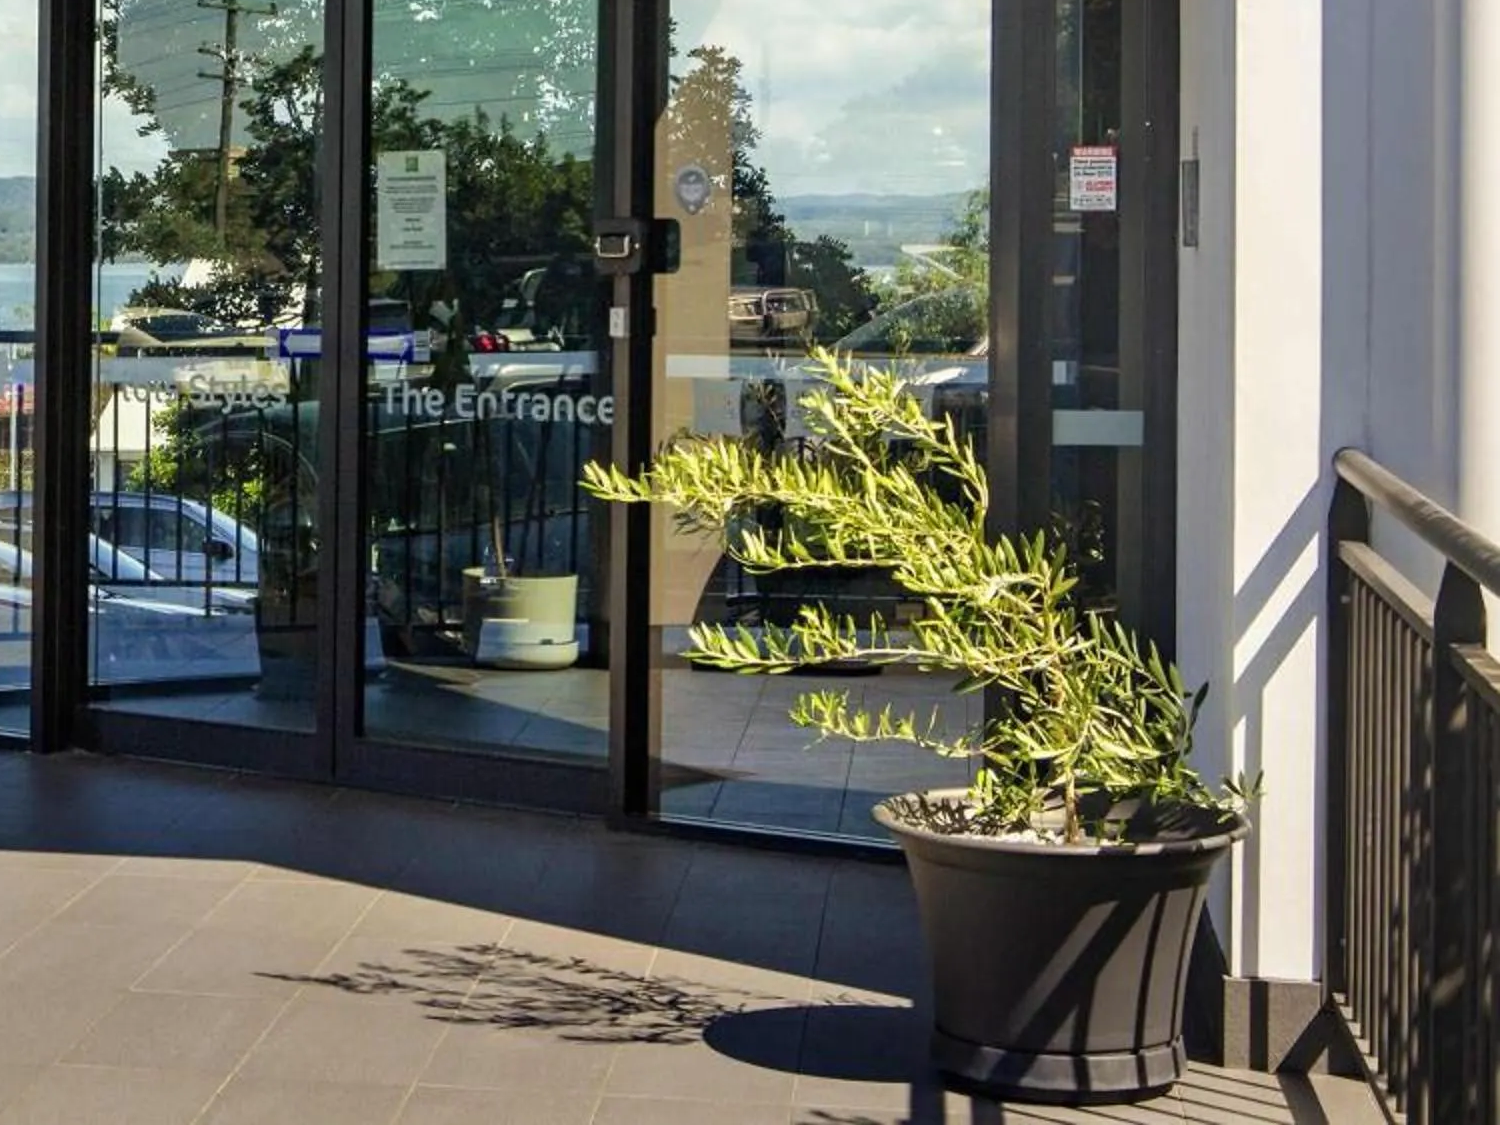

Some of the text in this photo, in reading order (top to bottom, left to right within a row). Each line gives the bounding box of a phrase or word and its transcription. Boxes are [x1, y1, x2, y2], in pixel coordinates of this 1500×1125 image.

[190, 374, 286, 414] Styles
[383, 381, 445, 415] The
[455, 384, 614, 424] Entrance
